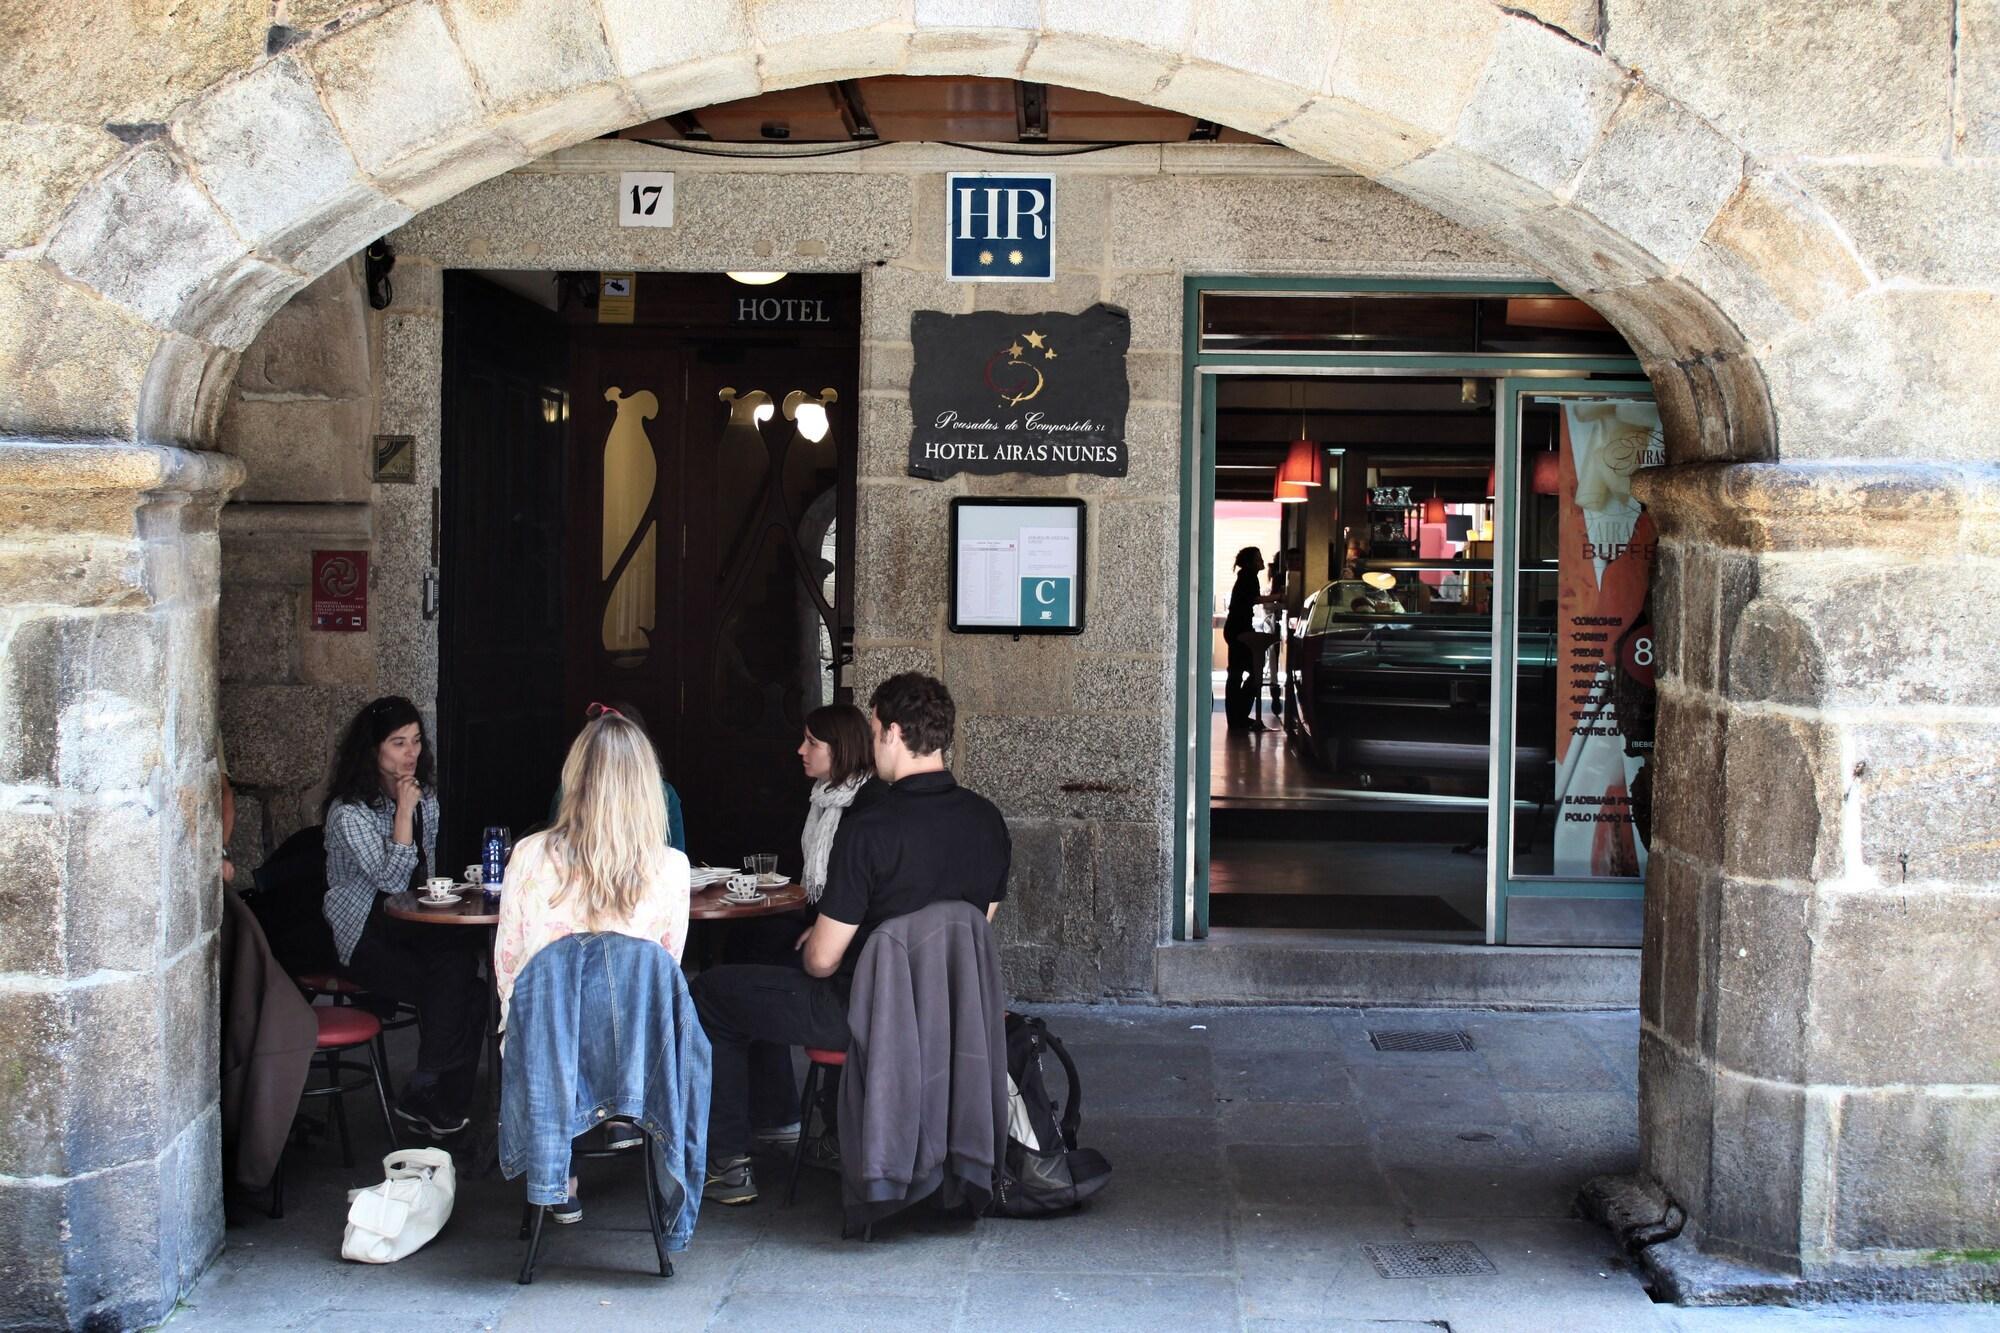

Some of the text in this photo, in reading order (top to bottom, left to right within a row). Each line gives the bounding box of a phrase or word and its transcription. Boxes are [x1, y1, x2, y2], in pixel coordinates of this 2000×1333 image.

[630, 184, 664, 216] 17
[955, 187, 1048, 240] HR
[737, 298, 831, 323] HOTEL
[934, 410, 1000, 431] Pousadas
[1004, 418, 1020, 431] de
[1024, 411, 1094, 435] Compostela
[924, 442, 1118, 463] HOTEL AIRAS NUNES
[1035, 579, 1056, 605] C
[1565, 812, 1592, 822] POLO
